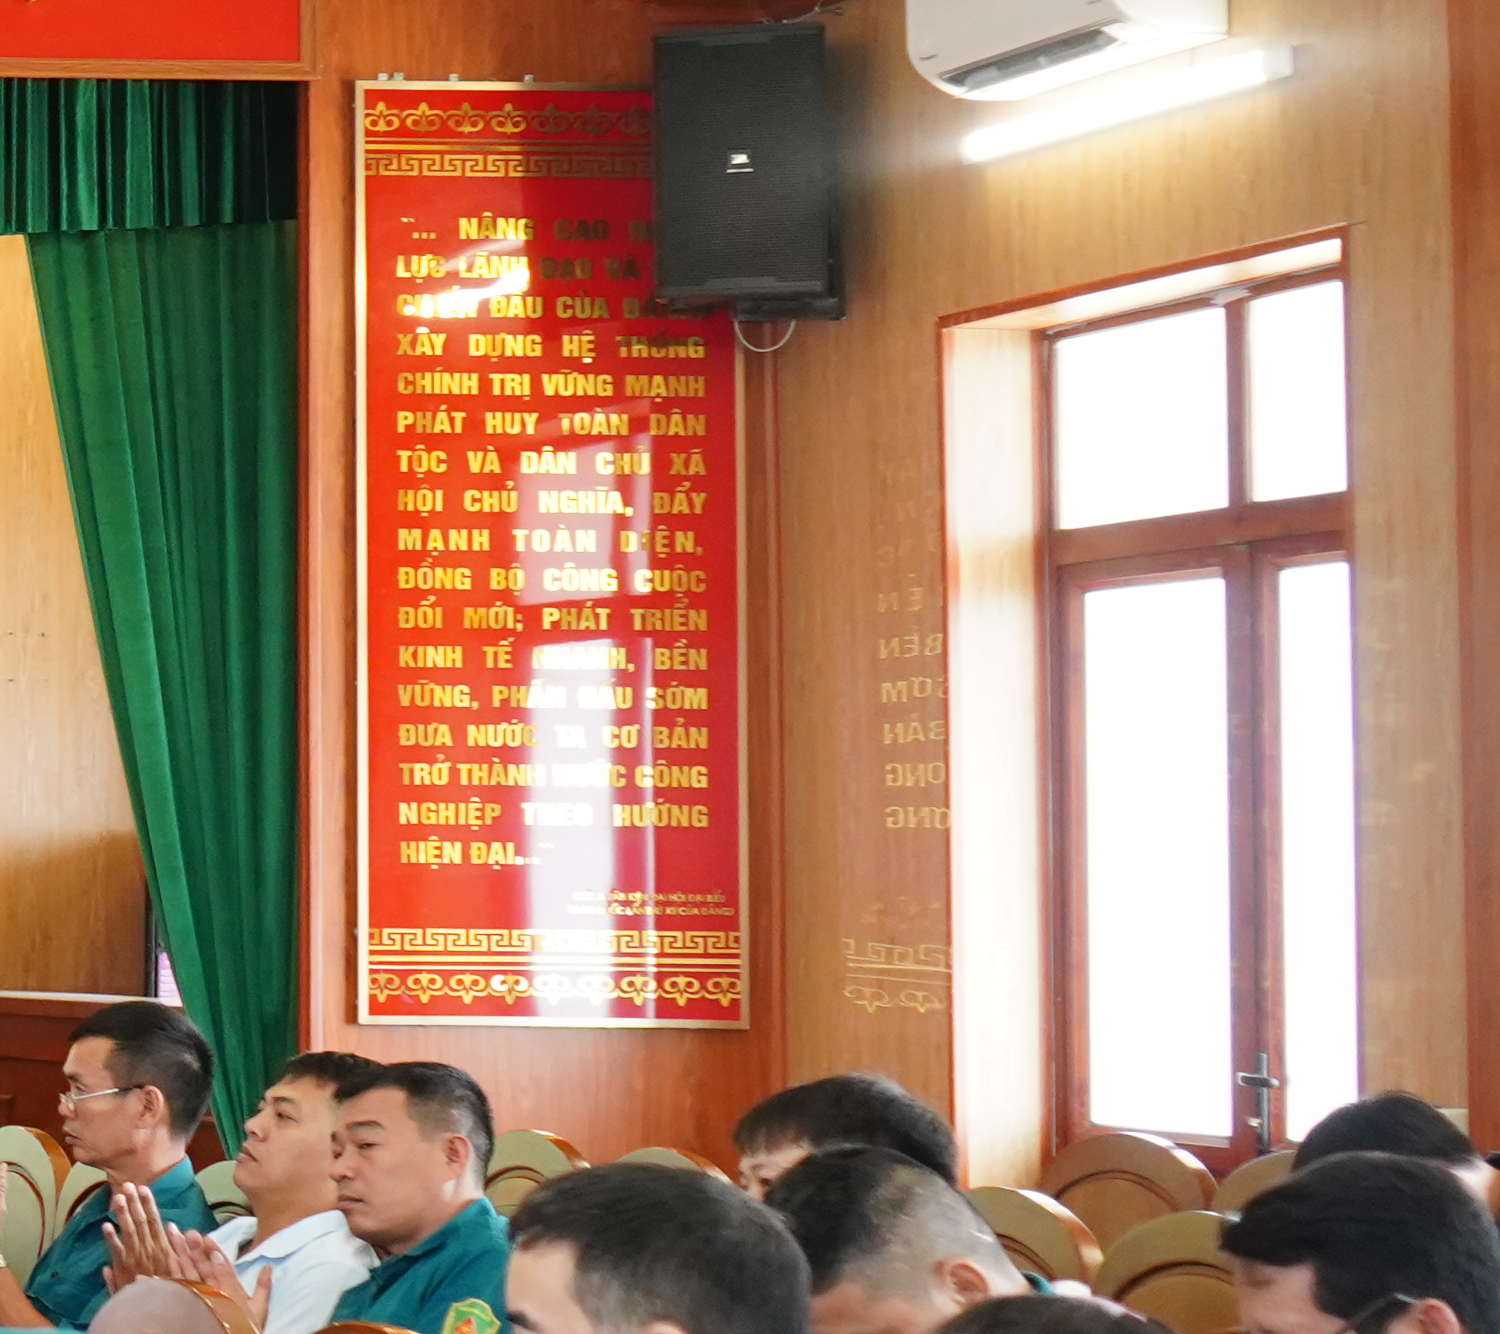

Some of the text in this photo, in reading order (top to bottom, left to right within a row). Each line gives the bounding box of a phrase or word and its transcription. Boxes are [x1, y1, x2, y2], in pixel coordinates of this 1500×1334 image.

[459, 212, 534, 240] NÂNG
[554, 218, 608, 241] CAO
[396, 253, 446, 283] LỰC
[556, 291, 610, 318] CỦA
[397, 327, 705, 362] XÂY DỰNG HỆ THỐNG
[397, 368, 706, 402] CHÍNH TRỊ VỮNG MẠNH
[397, 405, 706, 436] PHÁT HUY TOÀN DÂN
[397, 445, 706, 477] TỘC VÀ DÂN CHỦ XÃ
[398, 482, 707, 516] HỘI CHỦ NGHĨA, ĐẨY
[398, 529, 490, 555] MẠNH
[513, 524, 597, 552] TOÀN
[397, 557, 706, 597] ĐỒNG BỘ CÔNG CUỘC
[398, 597, 442, 629] ĐỔI
[542, 602, 611, 630] PHÁT
[631, 600, 707, 631] TRIỂN
[399, 646, 463, 668] KINH
[483, 638, 515, 668] TẾ
[655, 639, 708, 670] BỀN
[397, 680, 479, 711] VỮNG,
[647, 681, 708, 710] SỚM
[399, 722, 453, 747] ĐƯA
[467, 719, 538, 748] NƯỚC
[602, 723, 640, 748] CƠ
[654, 718, 708, 750] BẢN
[399, 754, 452, 785] TRỞ
[457, 756, 546, 787] THÀNH
[635, 759, 708, 788] CÔNG
[399, 797, 501, 830] NGHIỆP
[612, 798, 709, 828] HƯỚNG
[400, 836, 462, 869] HIỆN
